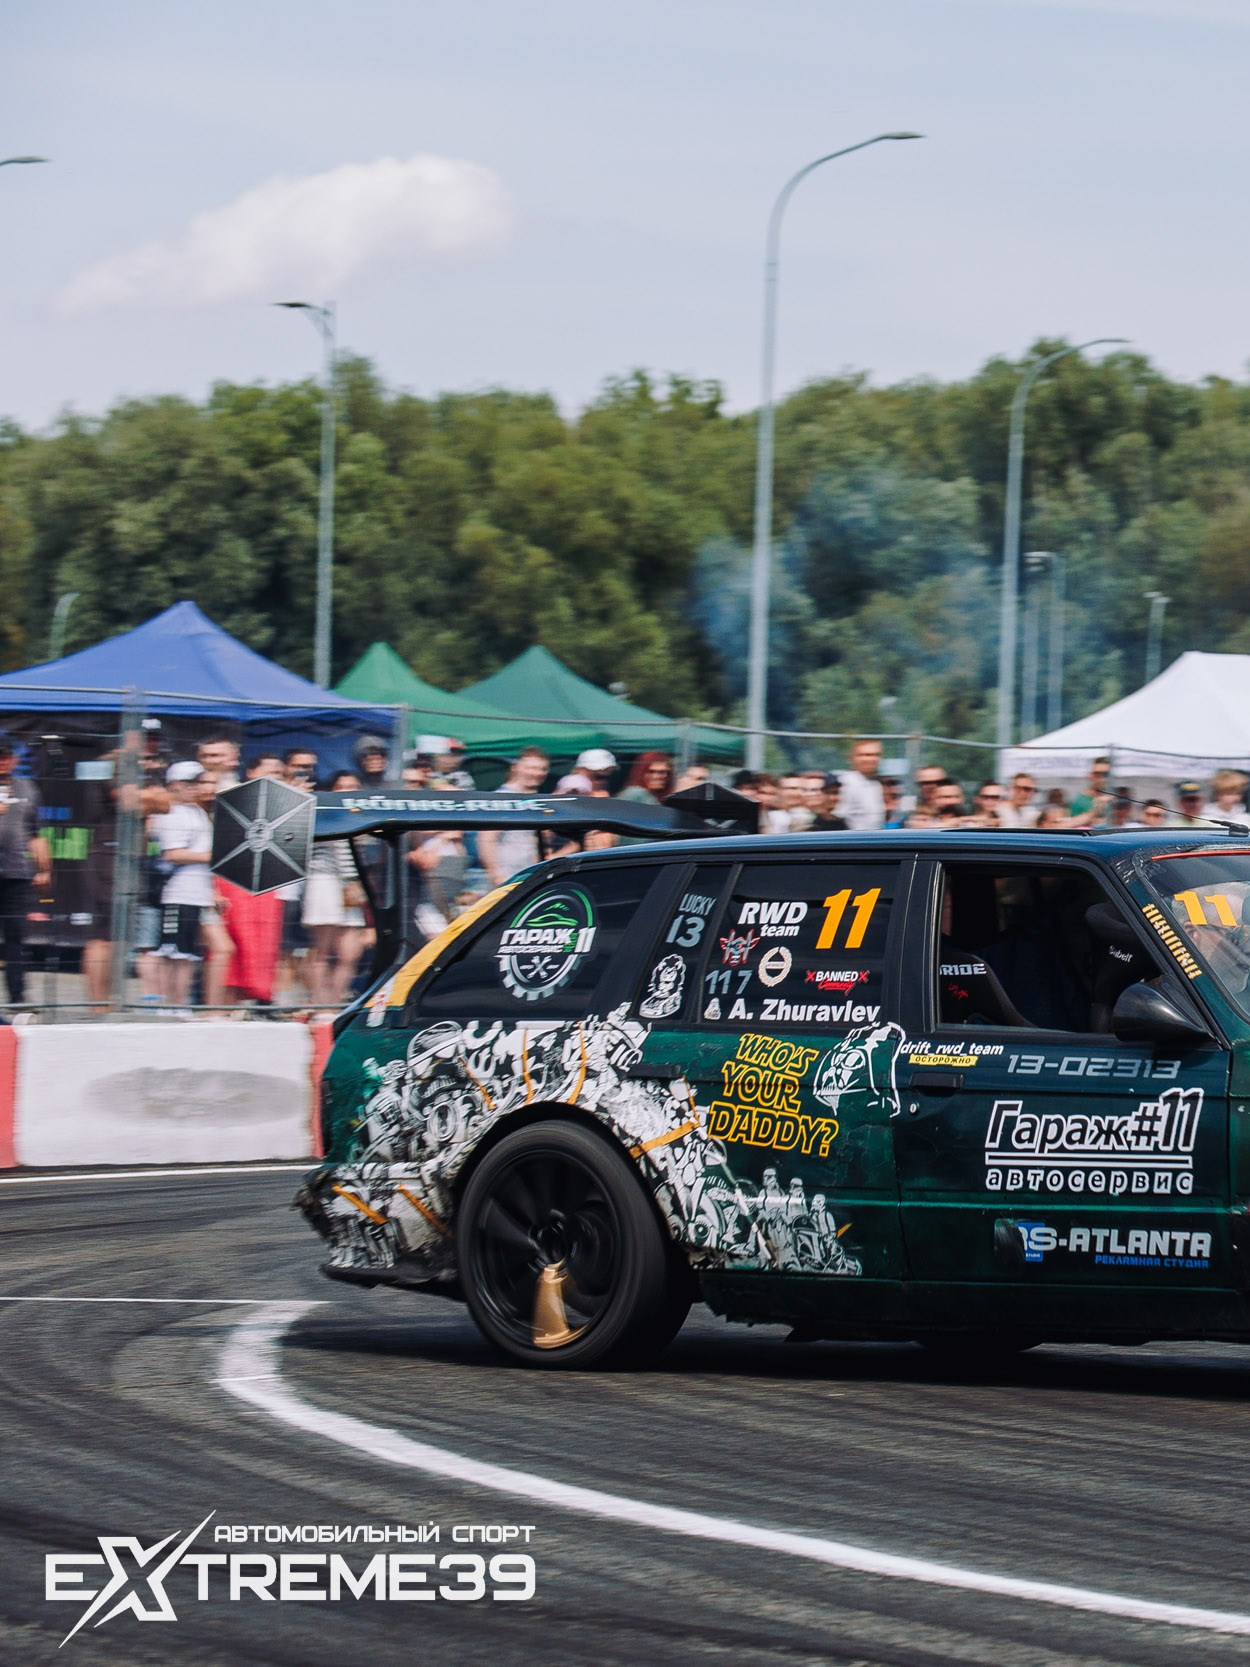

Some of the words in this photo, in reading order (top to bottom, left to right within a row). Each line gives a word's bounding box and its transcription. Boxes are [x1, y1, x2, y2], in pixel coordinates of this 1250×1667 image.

[678, 893, 717, 916] LUCKY
[737, 901, 808, 925] RWD
[1173, 890, 1238, 927] 11
[760, 924, 800, 937] team
[815, 887, 882, 949] 11
[500, 928, 576, 945] ГАРАЖ
[665, 915, 705, 948] 13
[940, 963, 987, 976] RIDE
[728, 998, 754, 1020] A.
[759, 998, 881, 1023] Zhuravlev
[736, 1033, 820, 1078] WHO'S
[900, 1042, 1004, 1057] drift_rwd_team
[914, 1055, 972, 1065] ОСТОРОЖНО
[1007, 1054, 1181, 1080] 13-02313
[721, 1060, 803, 1114] YOUR
[708, 1100, 840, 1158] DADDY?
[984, 1087, 1205, 1154] Гараж#11
[985, 1168, 1194, 1196] автосервис
